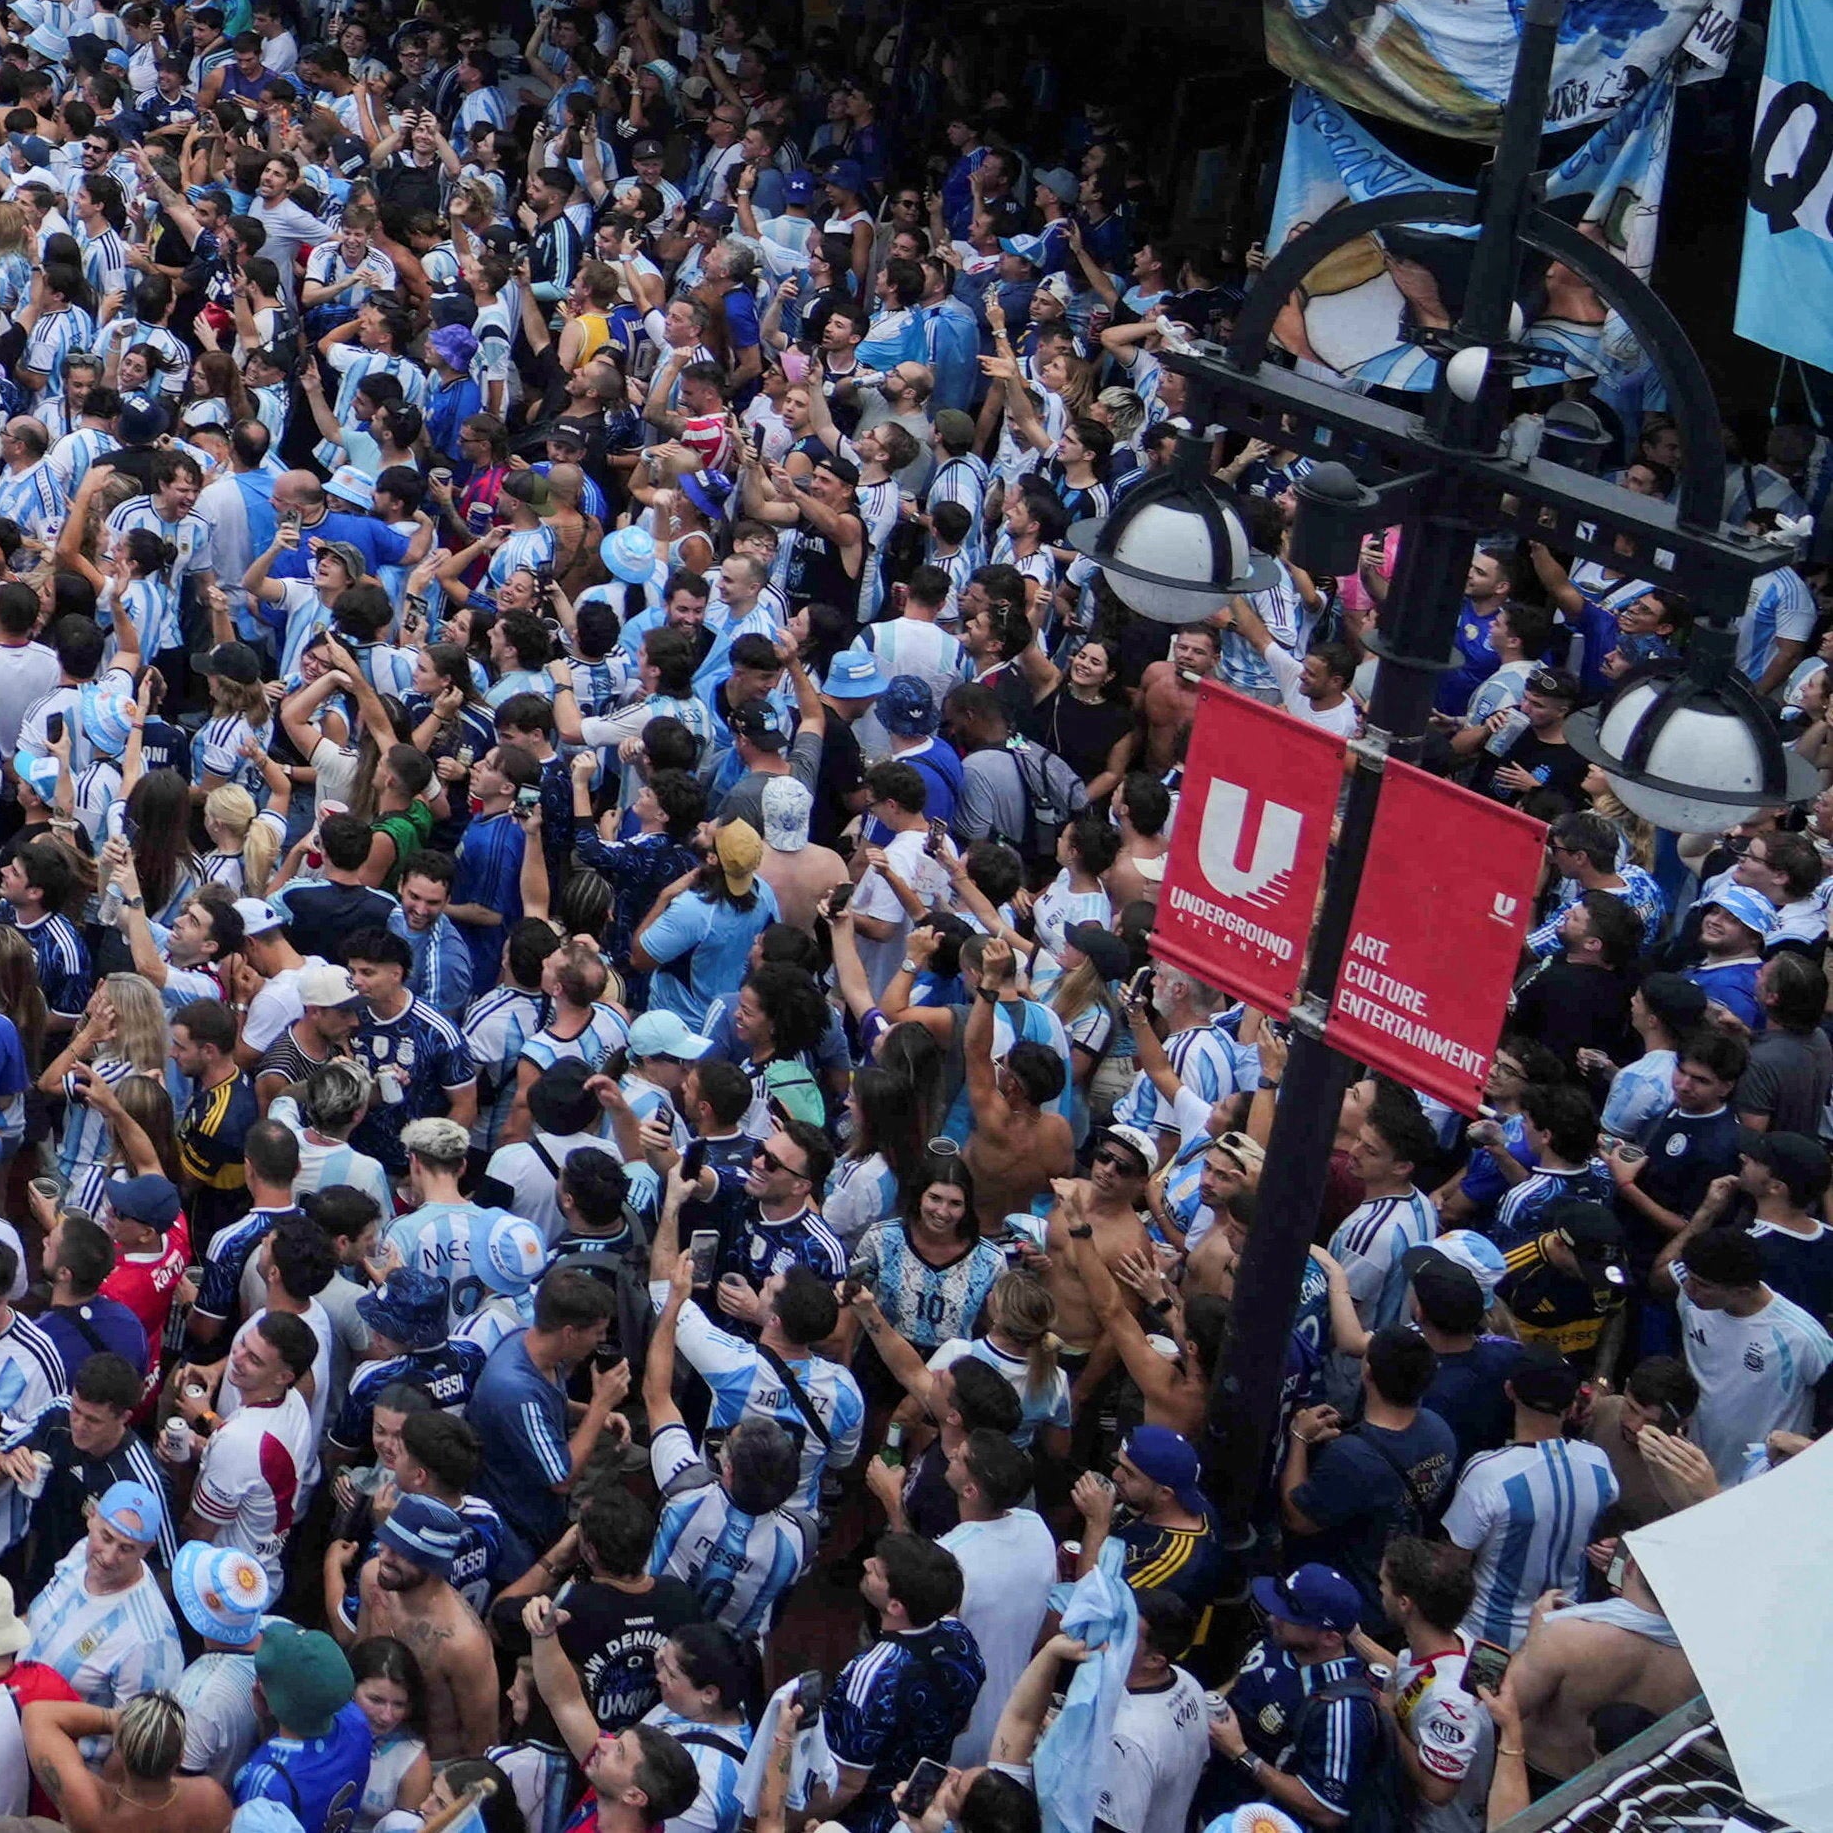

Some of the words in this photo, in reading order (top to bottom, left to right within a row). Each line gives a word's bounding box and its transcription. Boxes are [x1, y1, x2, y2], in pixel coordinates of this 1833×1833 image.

[1197, 776, 1305, 911] U
[1170, 885, 1294, 963] UNDERGROUND
[1492, 891, 1519, 918] U
[1176, 912, 1281, 968] ATLANTA
[1349, 931, 1391, 967] ART.
[1344, 960, 1429, 1018] CULTURE.
[1336, 988, 1489, 1082] ENTERTAINMENT.
